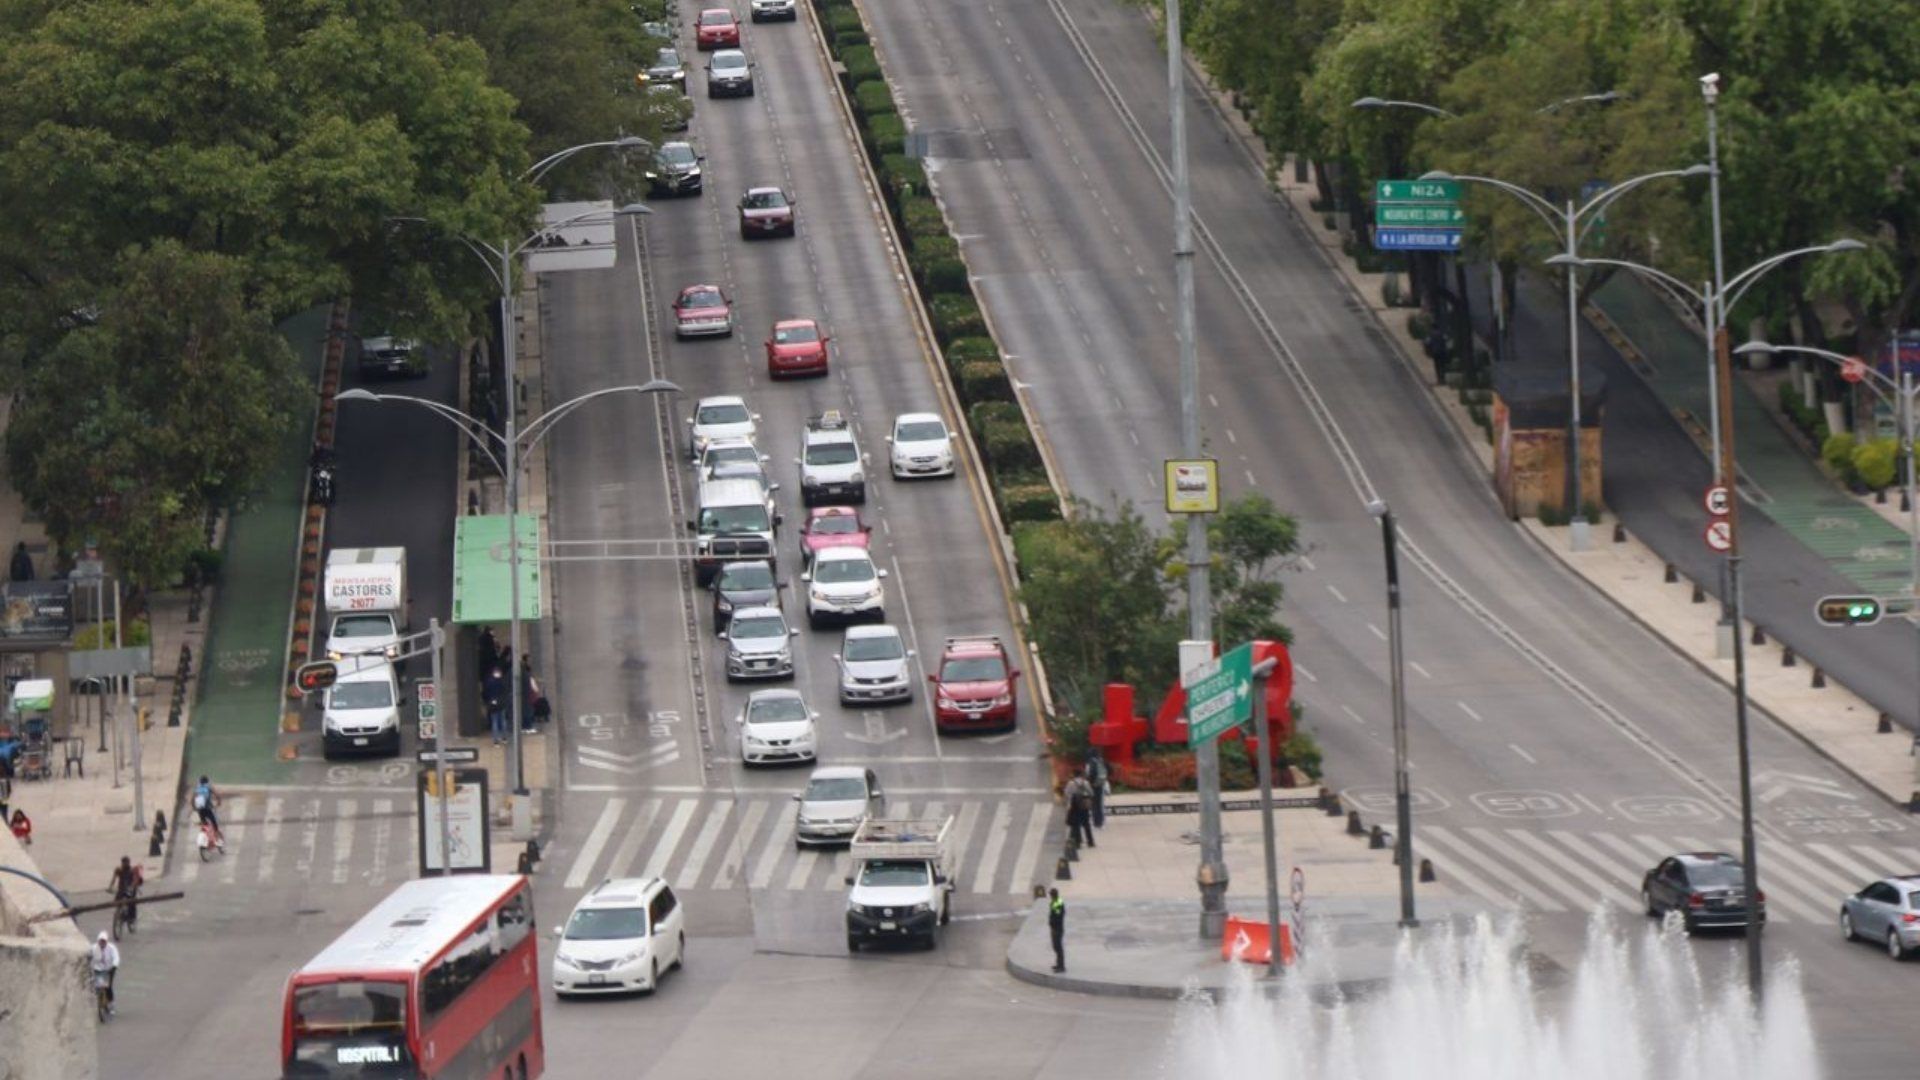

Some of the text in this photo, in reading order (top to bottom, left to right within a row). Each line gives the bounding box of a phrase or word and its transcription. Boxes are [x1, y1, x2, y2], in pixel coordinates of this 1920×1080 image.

[1411, 185, 1445, 197] NIZA
[332, 584, 392, 597] CASTORES
[1488, 797, 1559, 812] 50
[337, 1047, 392, 1063] HOSPITAL
